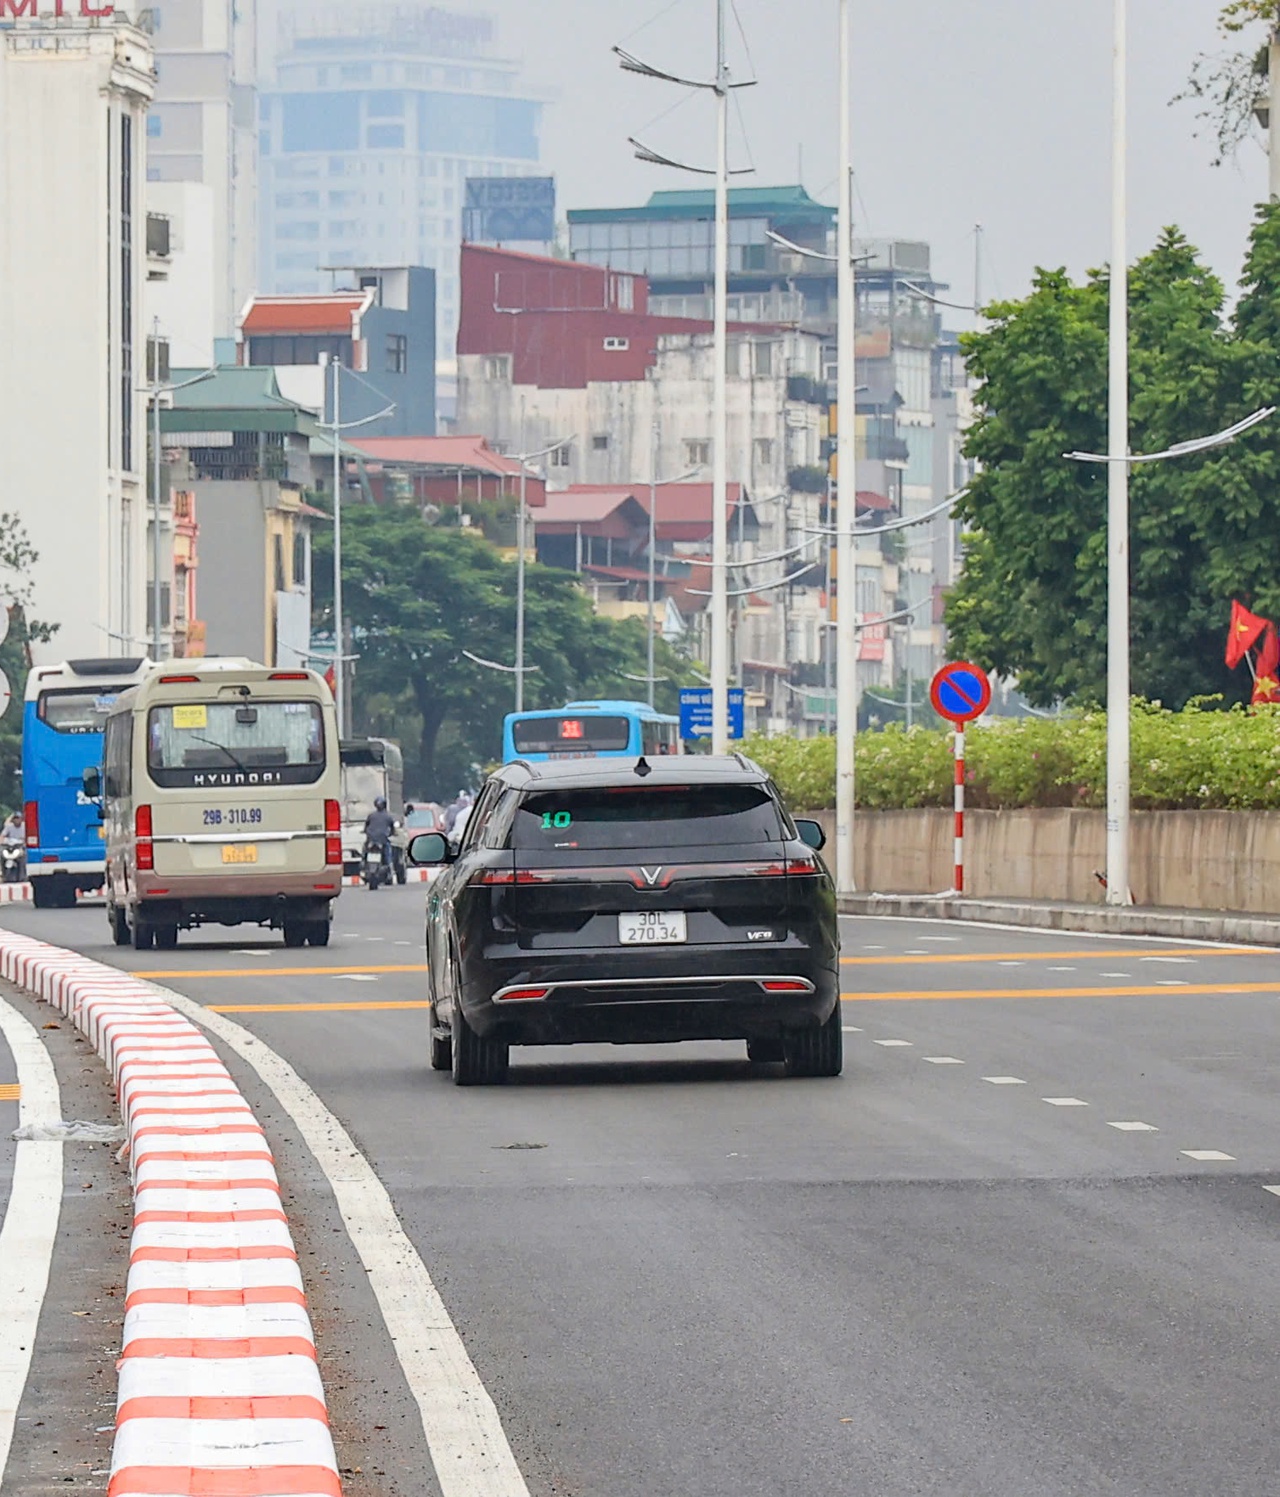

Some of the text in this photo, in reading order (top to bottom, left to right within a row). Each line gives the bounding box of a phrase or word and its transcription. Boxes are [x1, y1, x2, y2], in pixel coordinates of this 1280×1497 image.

[194, 773, 282, 785] HYUNDAI
[541, 811, 571, 829] 10
[639, 912, 665, 926] 30L
[628, 927, 678, 941] 270.34
